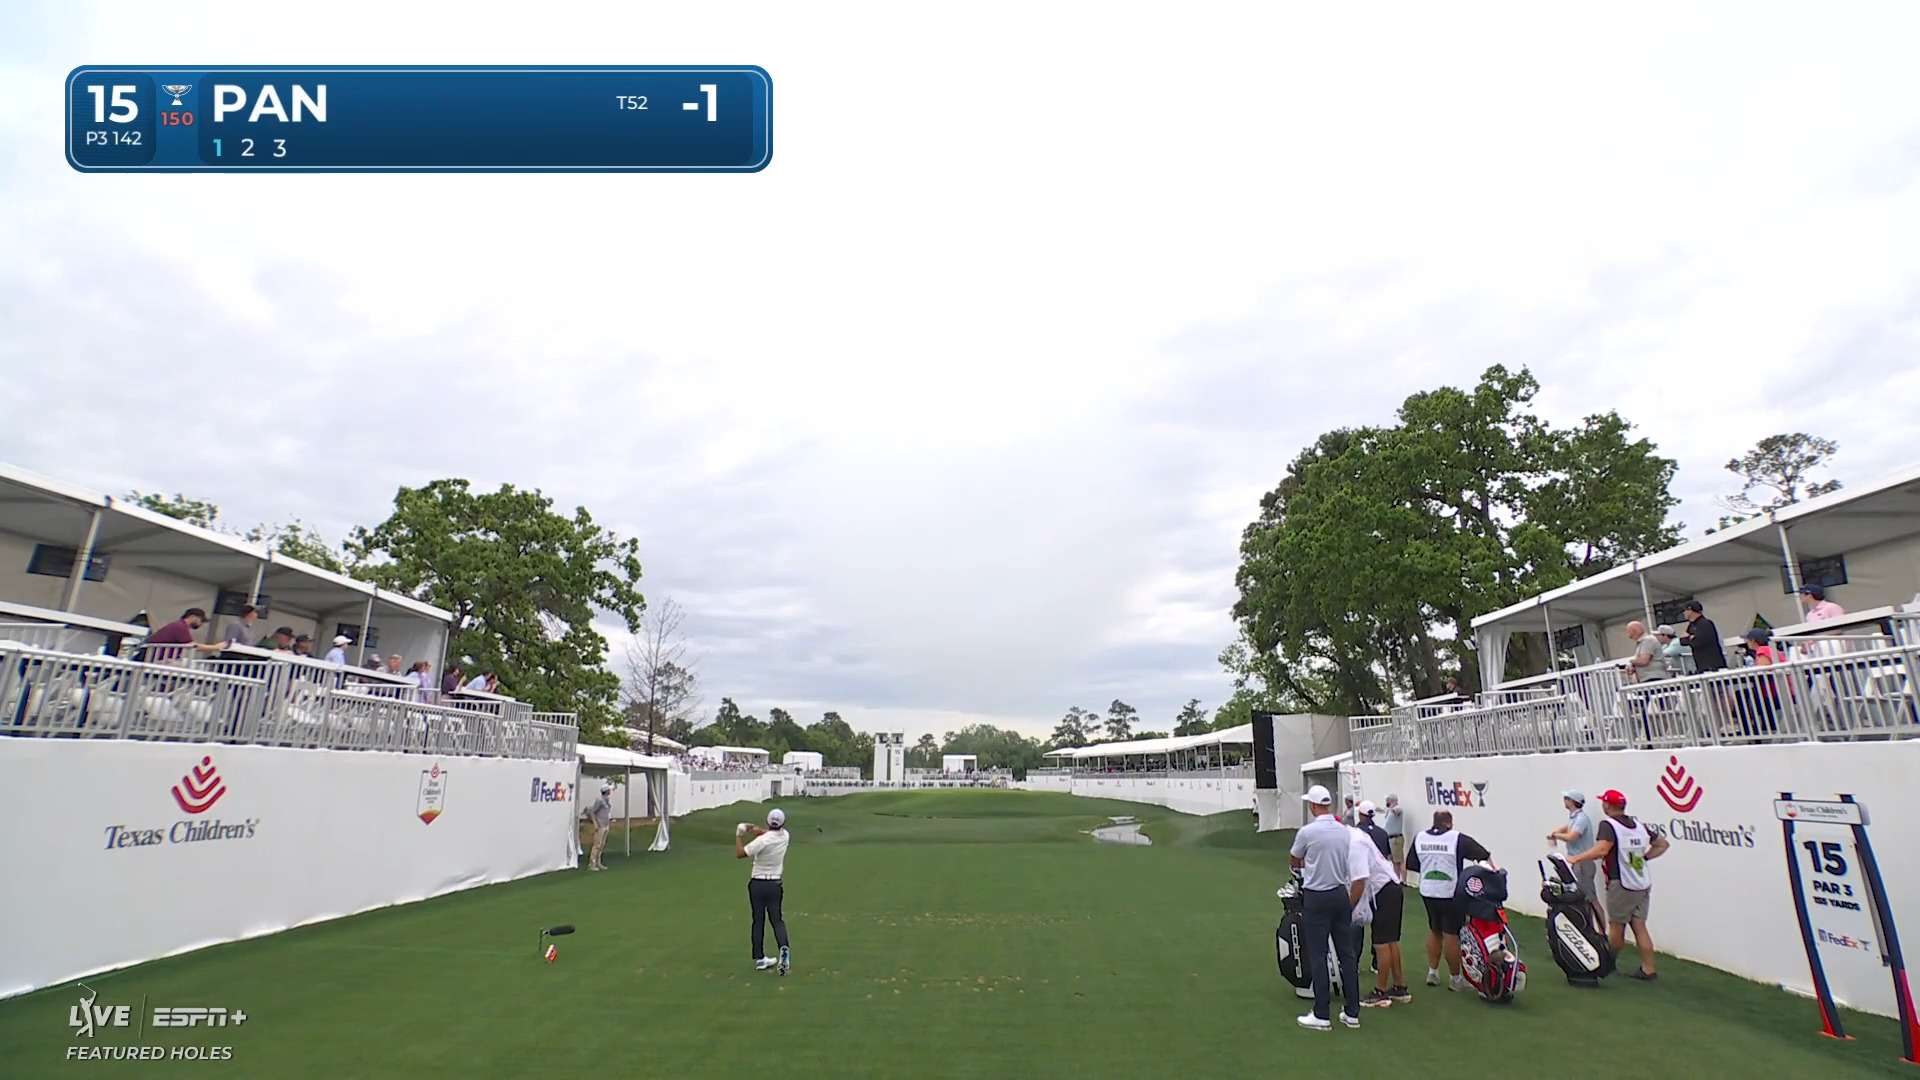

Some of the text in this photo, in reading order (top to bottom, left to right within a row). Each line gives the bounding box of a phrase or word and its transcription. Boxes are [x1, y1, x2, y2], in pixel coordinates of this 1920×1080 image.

[540, 781, 567, 802] FedEx
[1436, 781, 1473, 807] FedEx
[104, 819, 256, 850] Texas Children's
[1669, 818, 1755, 848] Children's
[1803, 840, 1847, 876] 15
[1812, 880, 1853, 897] PAR 3
[1829, 898, 1862, 912] YARDS
[1557, 923, 1596, 964] Titleist
[1828, 932, 1860, 949] FedEx
